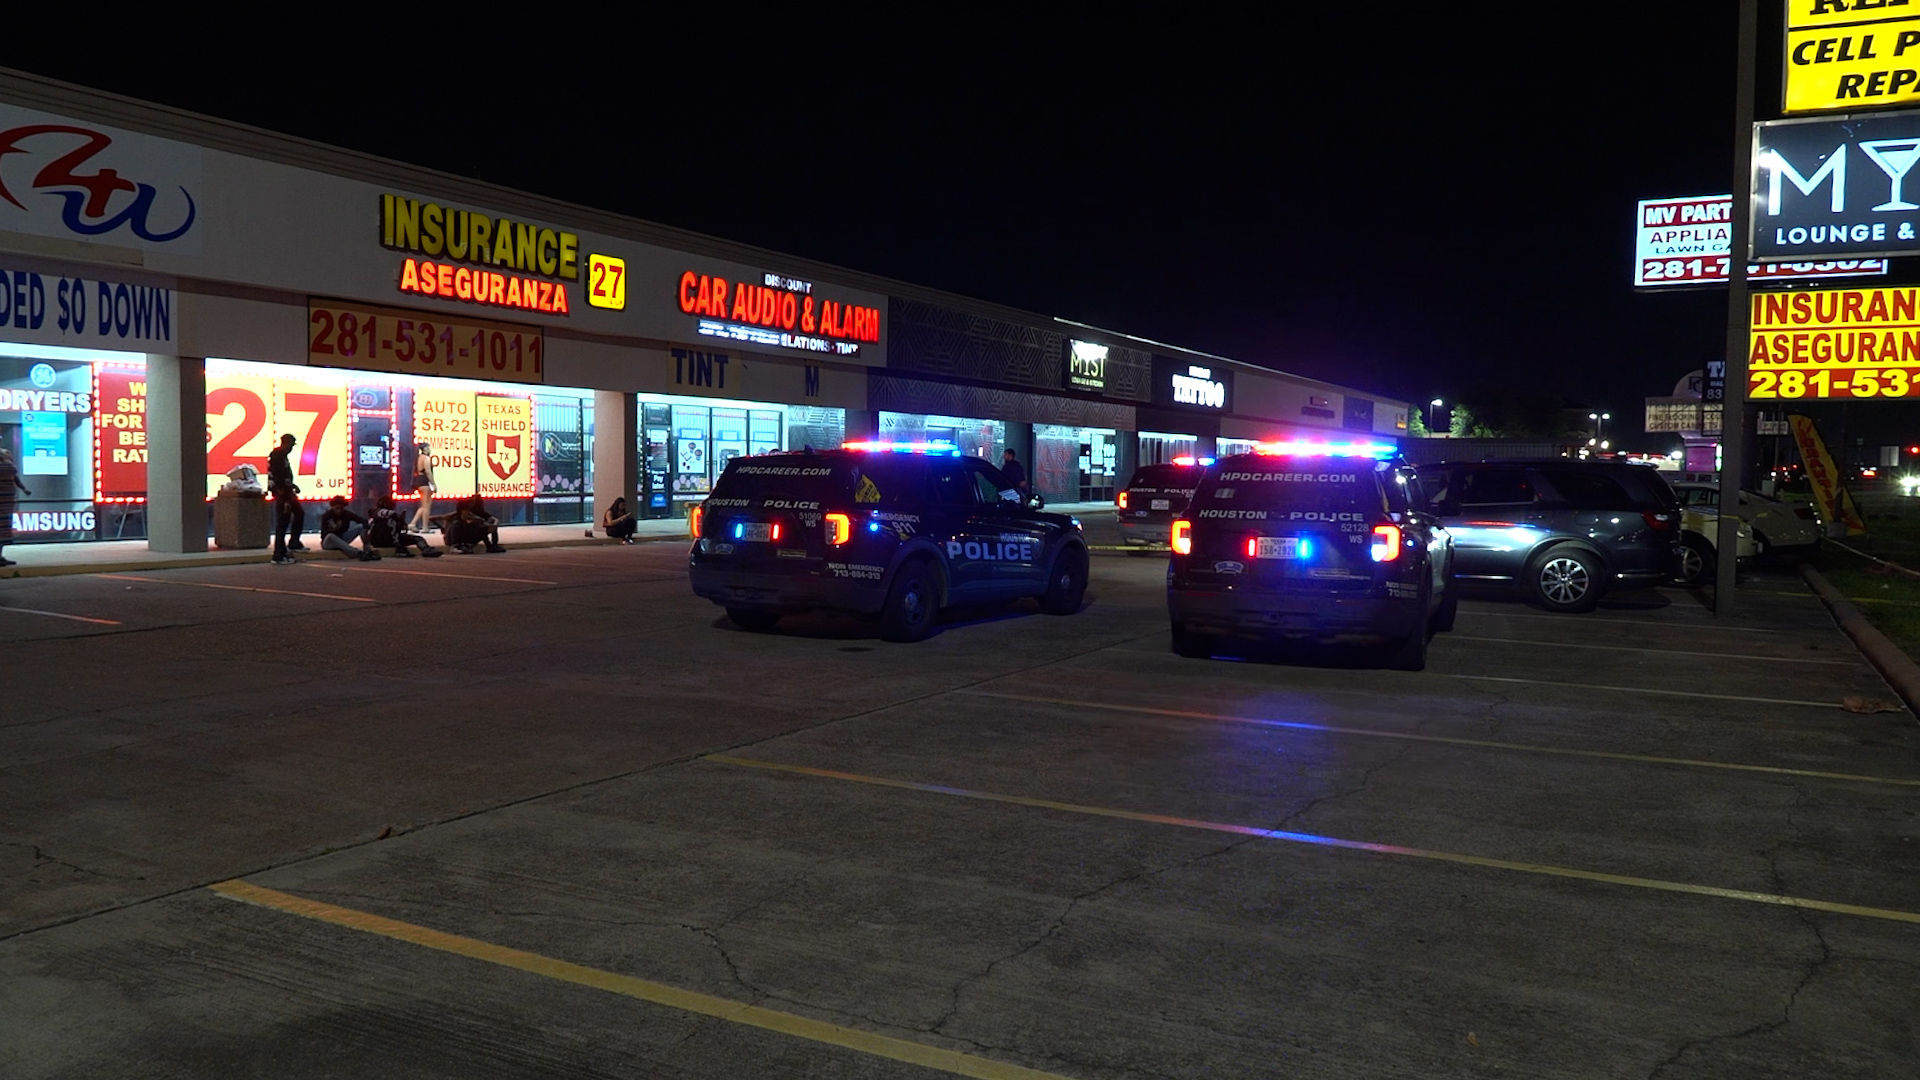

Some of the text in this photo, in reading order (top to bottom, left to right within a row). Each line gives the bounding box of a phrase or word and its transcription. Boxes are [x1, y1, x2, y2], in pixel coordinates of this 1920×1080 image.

[1792, 34, 1876, 66] CELL
[1646, 206, 1677, 224] MV
[381, 194, 579, 280] INSURANCE
[1776, 222, 1914, 245] LOUNGE &
[1656, 245, 1704, 254] LAWN
[401, 258, 570, 313] ASEGURANZA
[764, 273, 812, 294] DISCOUNT
[99, 281, 170, 341] DOWN
[680, 271, 728, 319] CAR
[732, 282, 796, 330] AUDIO
[802, 296, 815, 332] &
[820, 300, 879, 342] ALARM
[1754, 289, 1920, 325] INSURAN
[311, 310, 541, 374] 281-531-1011
[672, 348, 728, 388] TINT
[806, 365, 820, 397] M
[1172, 374, 1224, 408] TATTOO
[0, 389, 91, 413] DRYERS
[116, 398, 148, 413] SH
[424, 400, 468, 414] AUTO
[487, 404, 520, 414] TEXAS
[102, 414, 143, 428] FOR
[422, 418, 470, 432] SR-22
[482, 419, 526, 432] SHIELD
[118, 431, 148, 446] BE
[430, 455, 472, 468] ONDS
[500, 452, 509, 460] TX
[736, 466, 832, 476] HPDCAREER.COM
[1220, 472, 1356, 483] HPDCAREER.COM
[316, 478, 344, 488] & UP
[478, 482, 530, 492] INSURANCE
[707, 498, 820, 510] HOUSTON POLICE
[12, 511, 95, 532] AMSUNG
[1199, 510, 1364, 522] HOUSTON POLICE
[805, 520, 816, 528] WS
[892, 522, 916, 534] 911
[1340, 524, 1369, 532] 52128
[1349, 535, 1362, 544] WS
[946, 541, 1032, 560] POLICE
[828, 562, 884, 573] NON EMERGENCY
